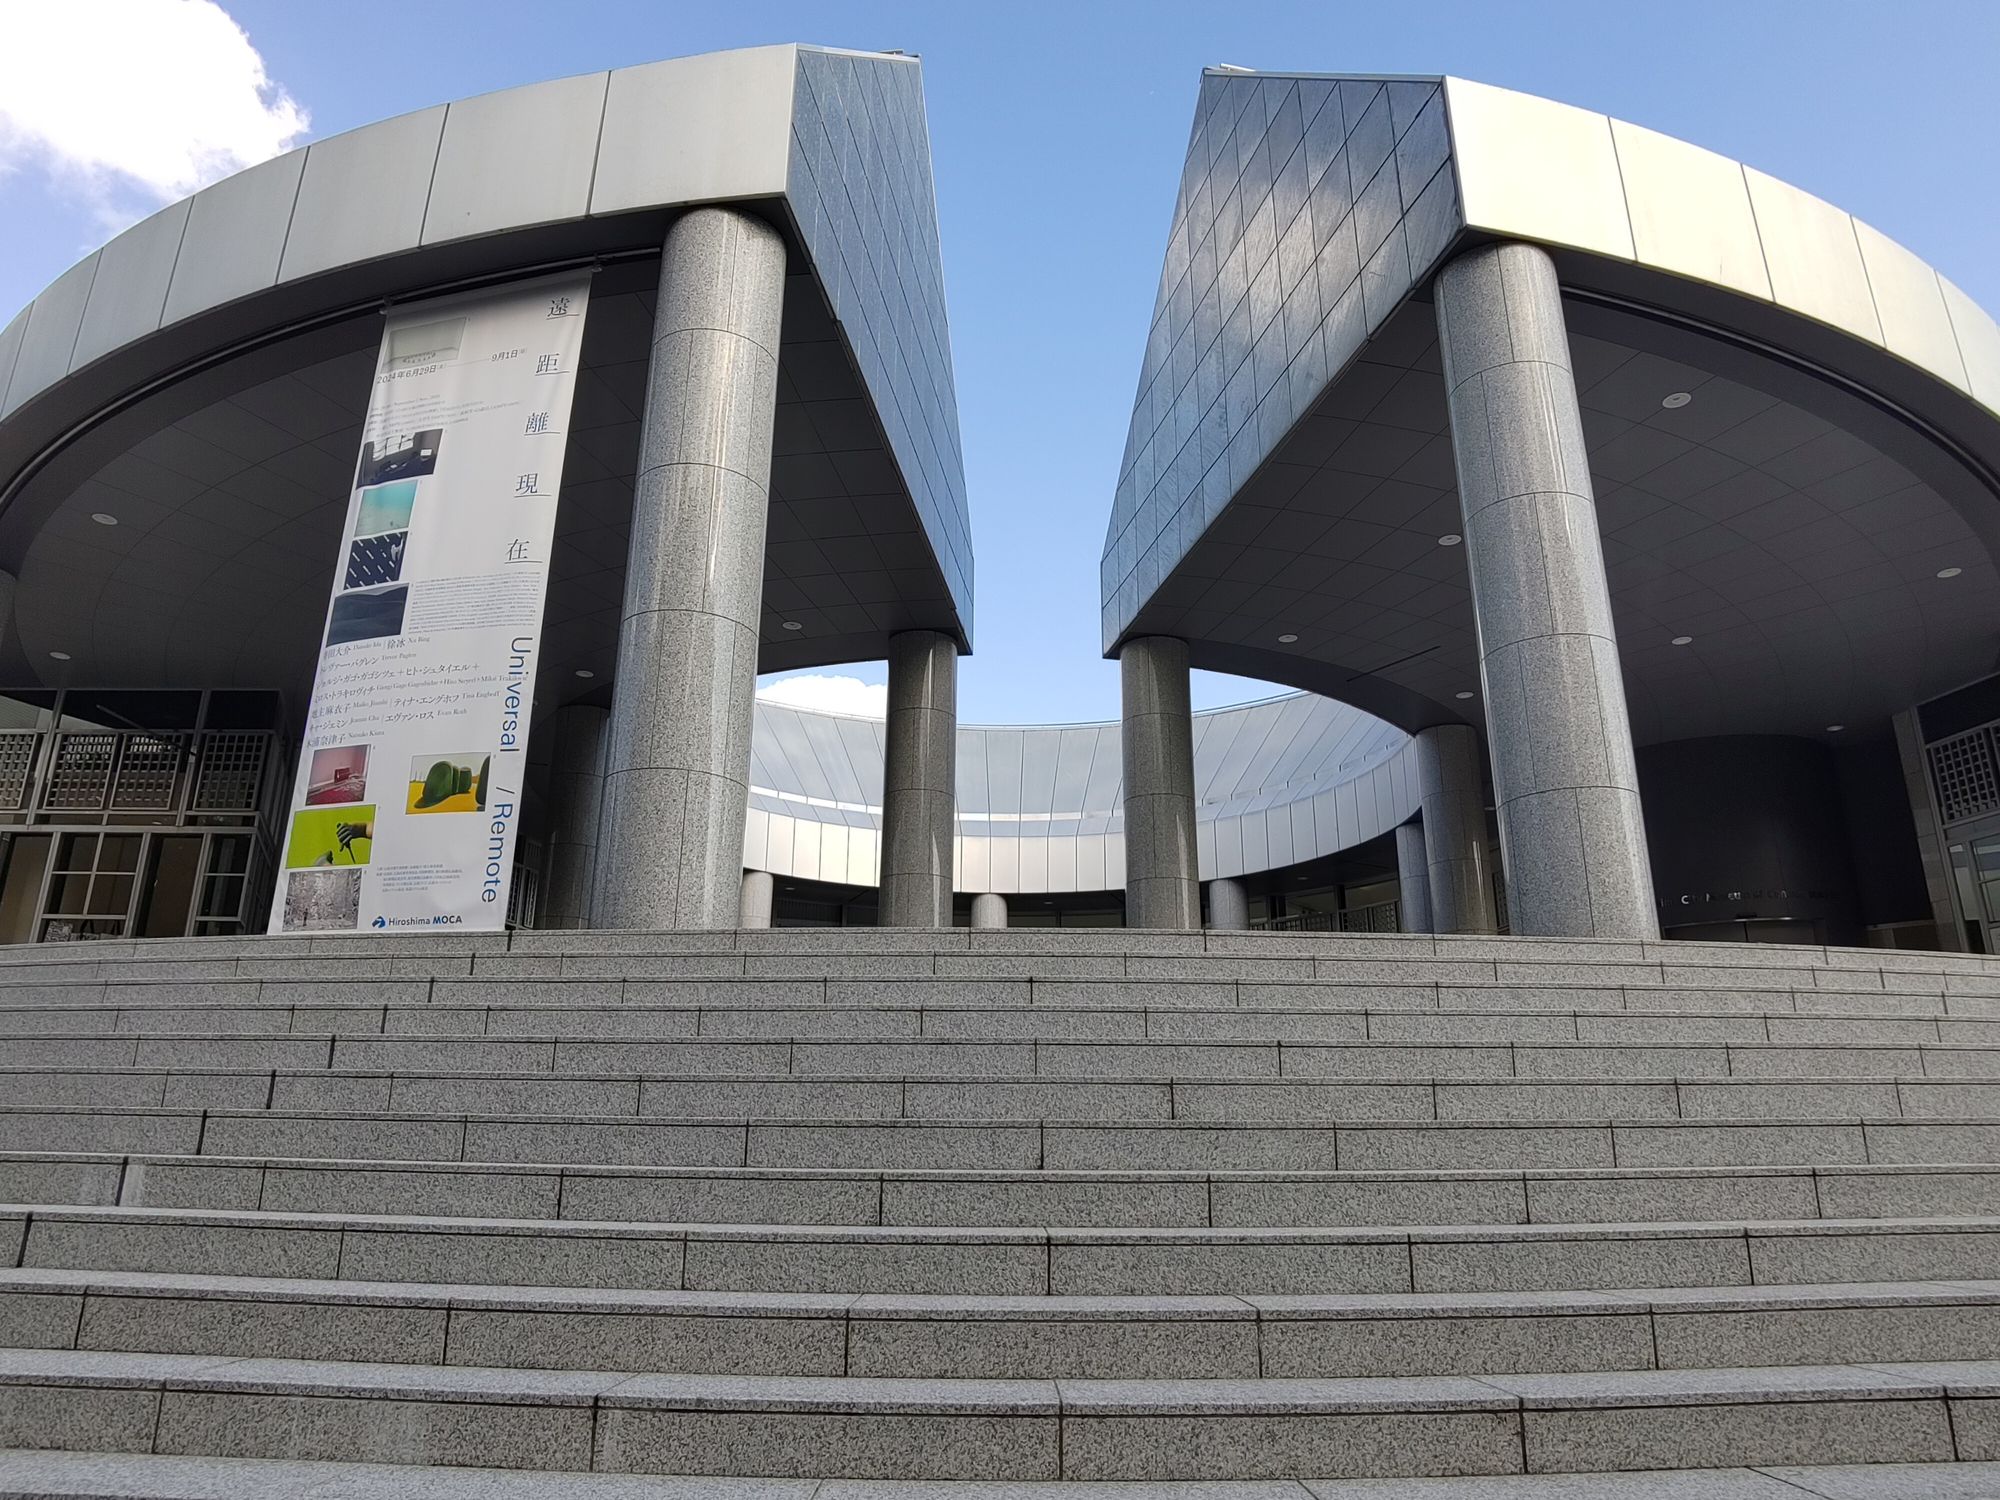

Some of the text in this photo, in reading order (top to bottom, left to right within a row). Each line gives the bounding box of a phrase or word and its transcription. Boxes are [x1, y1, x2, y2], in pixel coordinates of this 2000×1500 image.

[491, 349, 518, 362] 9月1日
[505, 298, 571, 561] 遠距離現在
[385, 711, 434, 723] エヴァン・ロス
[500, 636, 534, 752] Universal
[481, 802, 514, 904] Remote
[388, 915, 463, 926] Hiroshima MOCA
